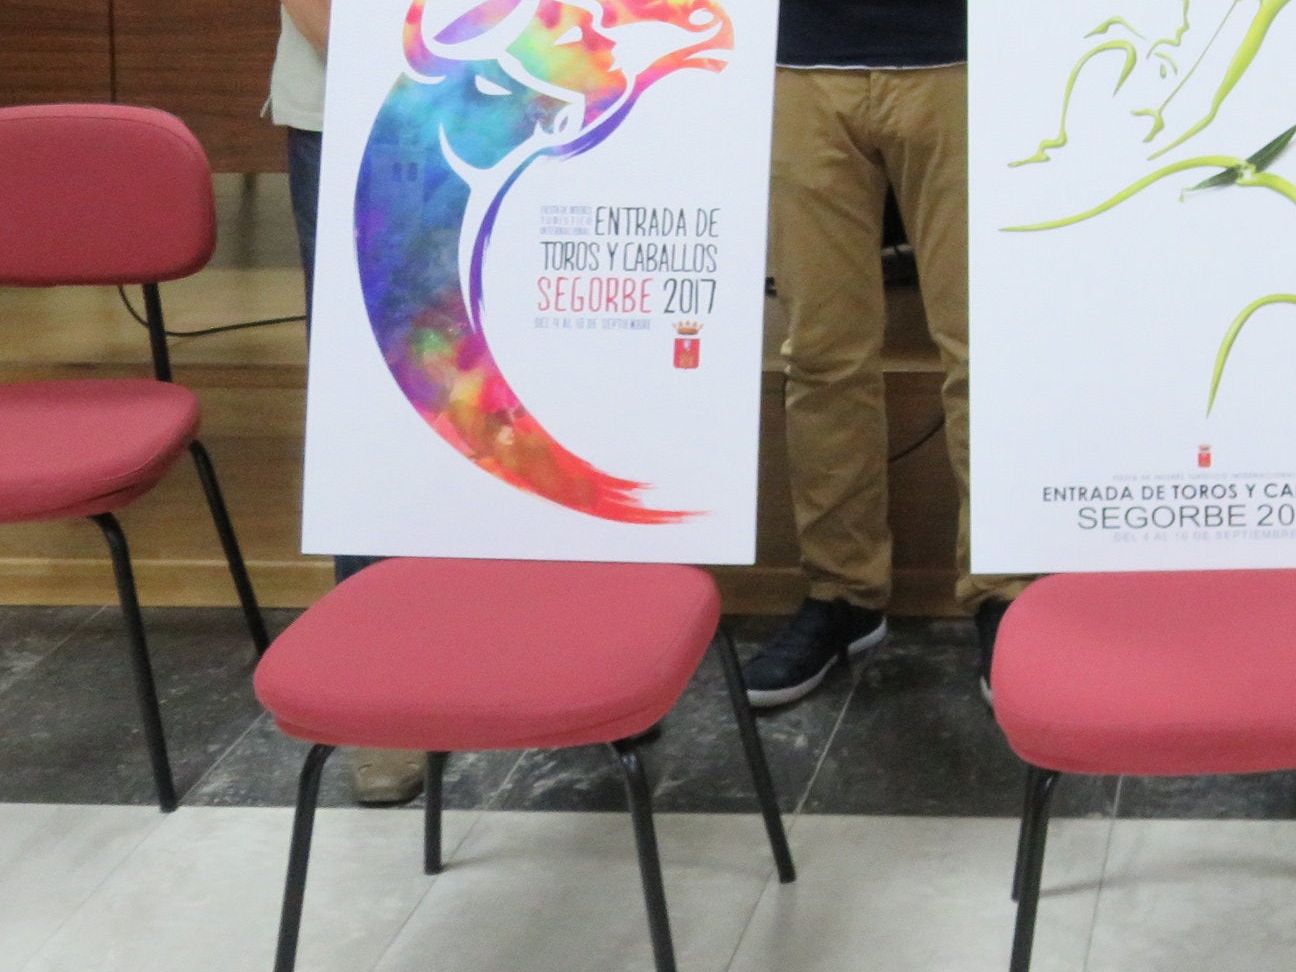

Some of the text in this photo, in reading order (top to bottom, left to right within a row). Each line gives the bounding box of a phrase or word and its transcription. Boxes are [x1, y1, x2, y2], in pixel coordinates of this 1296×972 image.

[594, 205, 722, 238] ENTRADA DE
[539, 241, 719, 273] TOROS Y CABALLOS
[536, 275, 717, 315] SEGORBE 2017
[1042, 486, 1133, 502] ENTRADA
[1141, 485, 1165, 500] DE
[1172, 484, 1238, 500] TOROS
[1245, 483, 1255, 498] Y
[1077, 504, 1247, 530] SEGORBE
